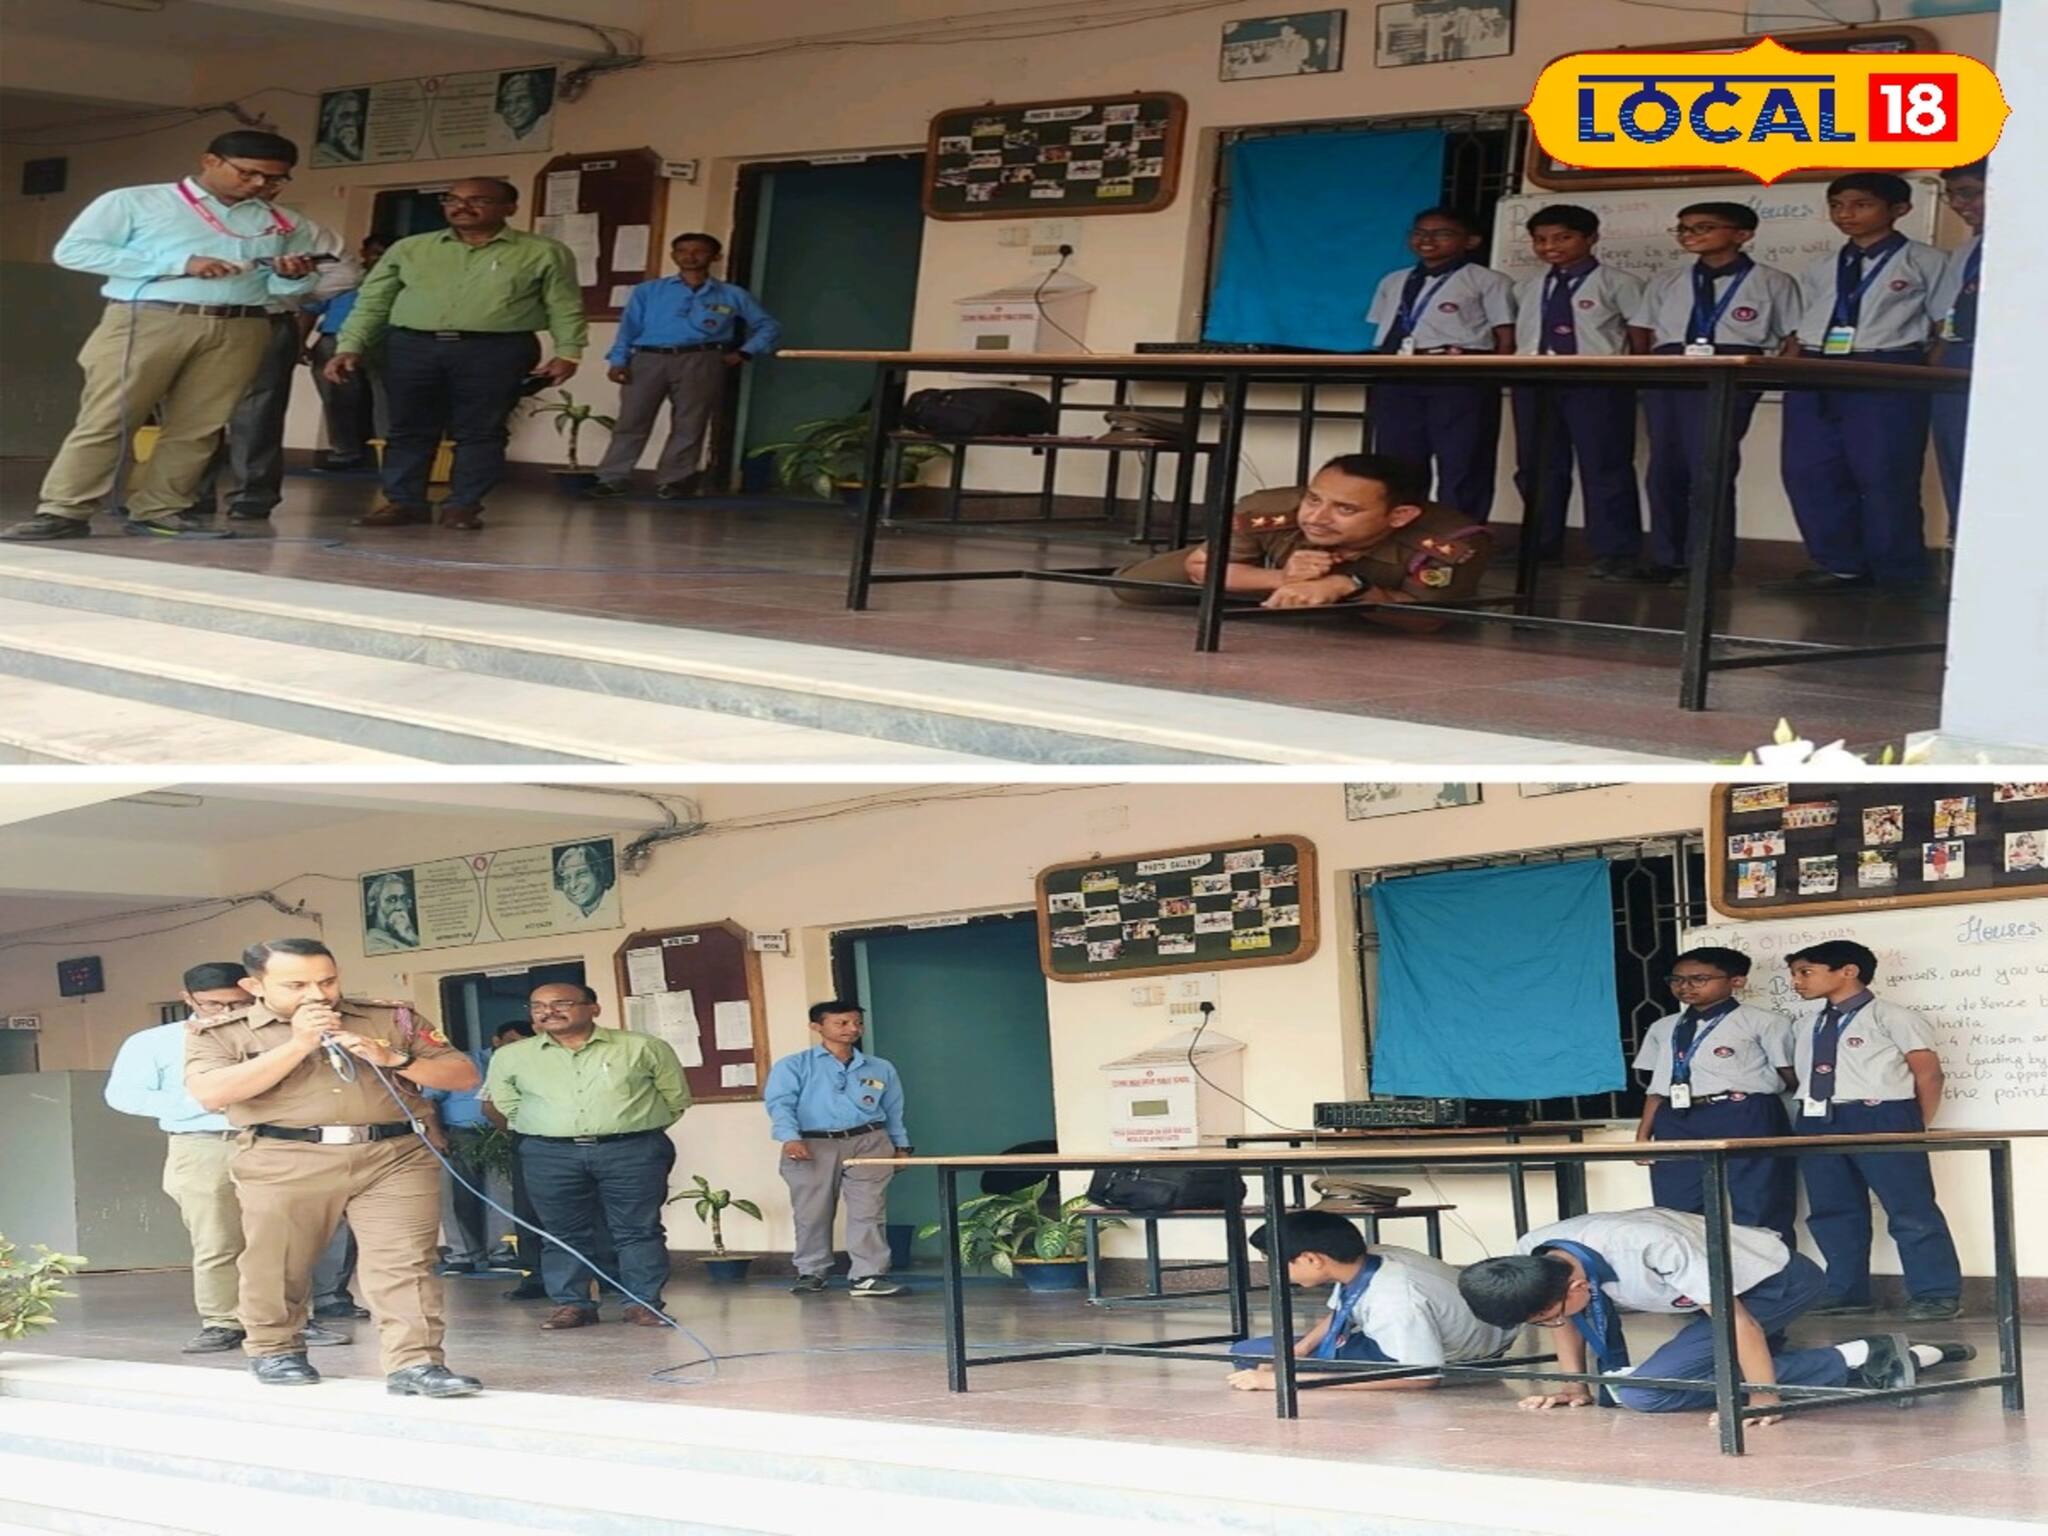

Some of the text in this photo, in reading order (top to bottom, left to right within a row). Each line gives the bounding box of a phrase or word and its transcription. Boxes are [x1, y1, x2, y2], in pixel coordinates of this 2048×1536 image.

[1957, 914, 2042, 944] Houses
[1995, 965, 2029, 986] you
[1943, 1086, 1980, 1100] the
